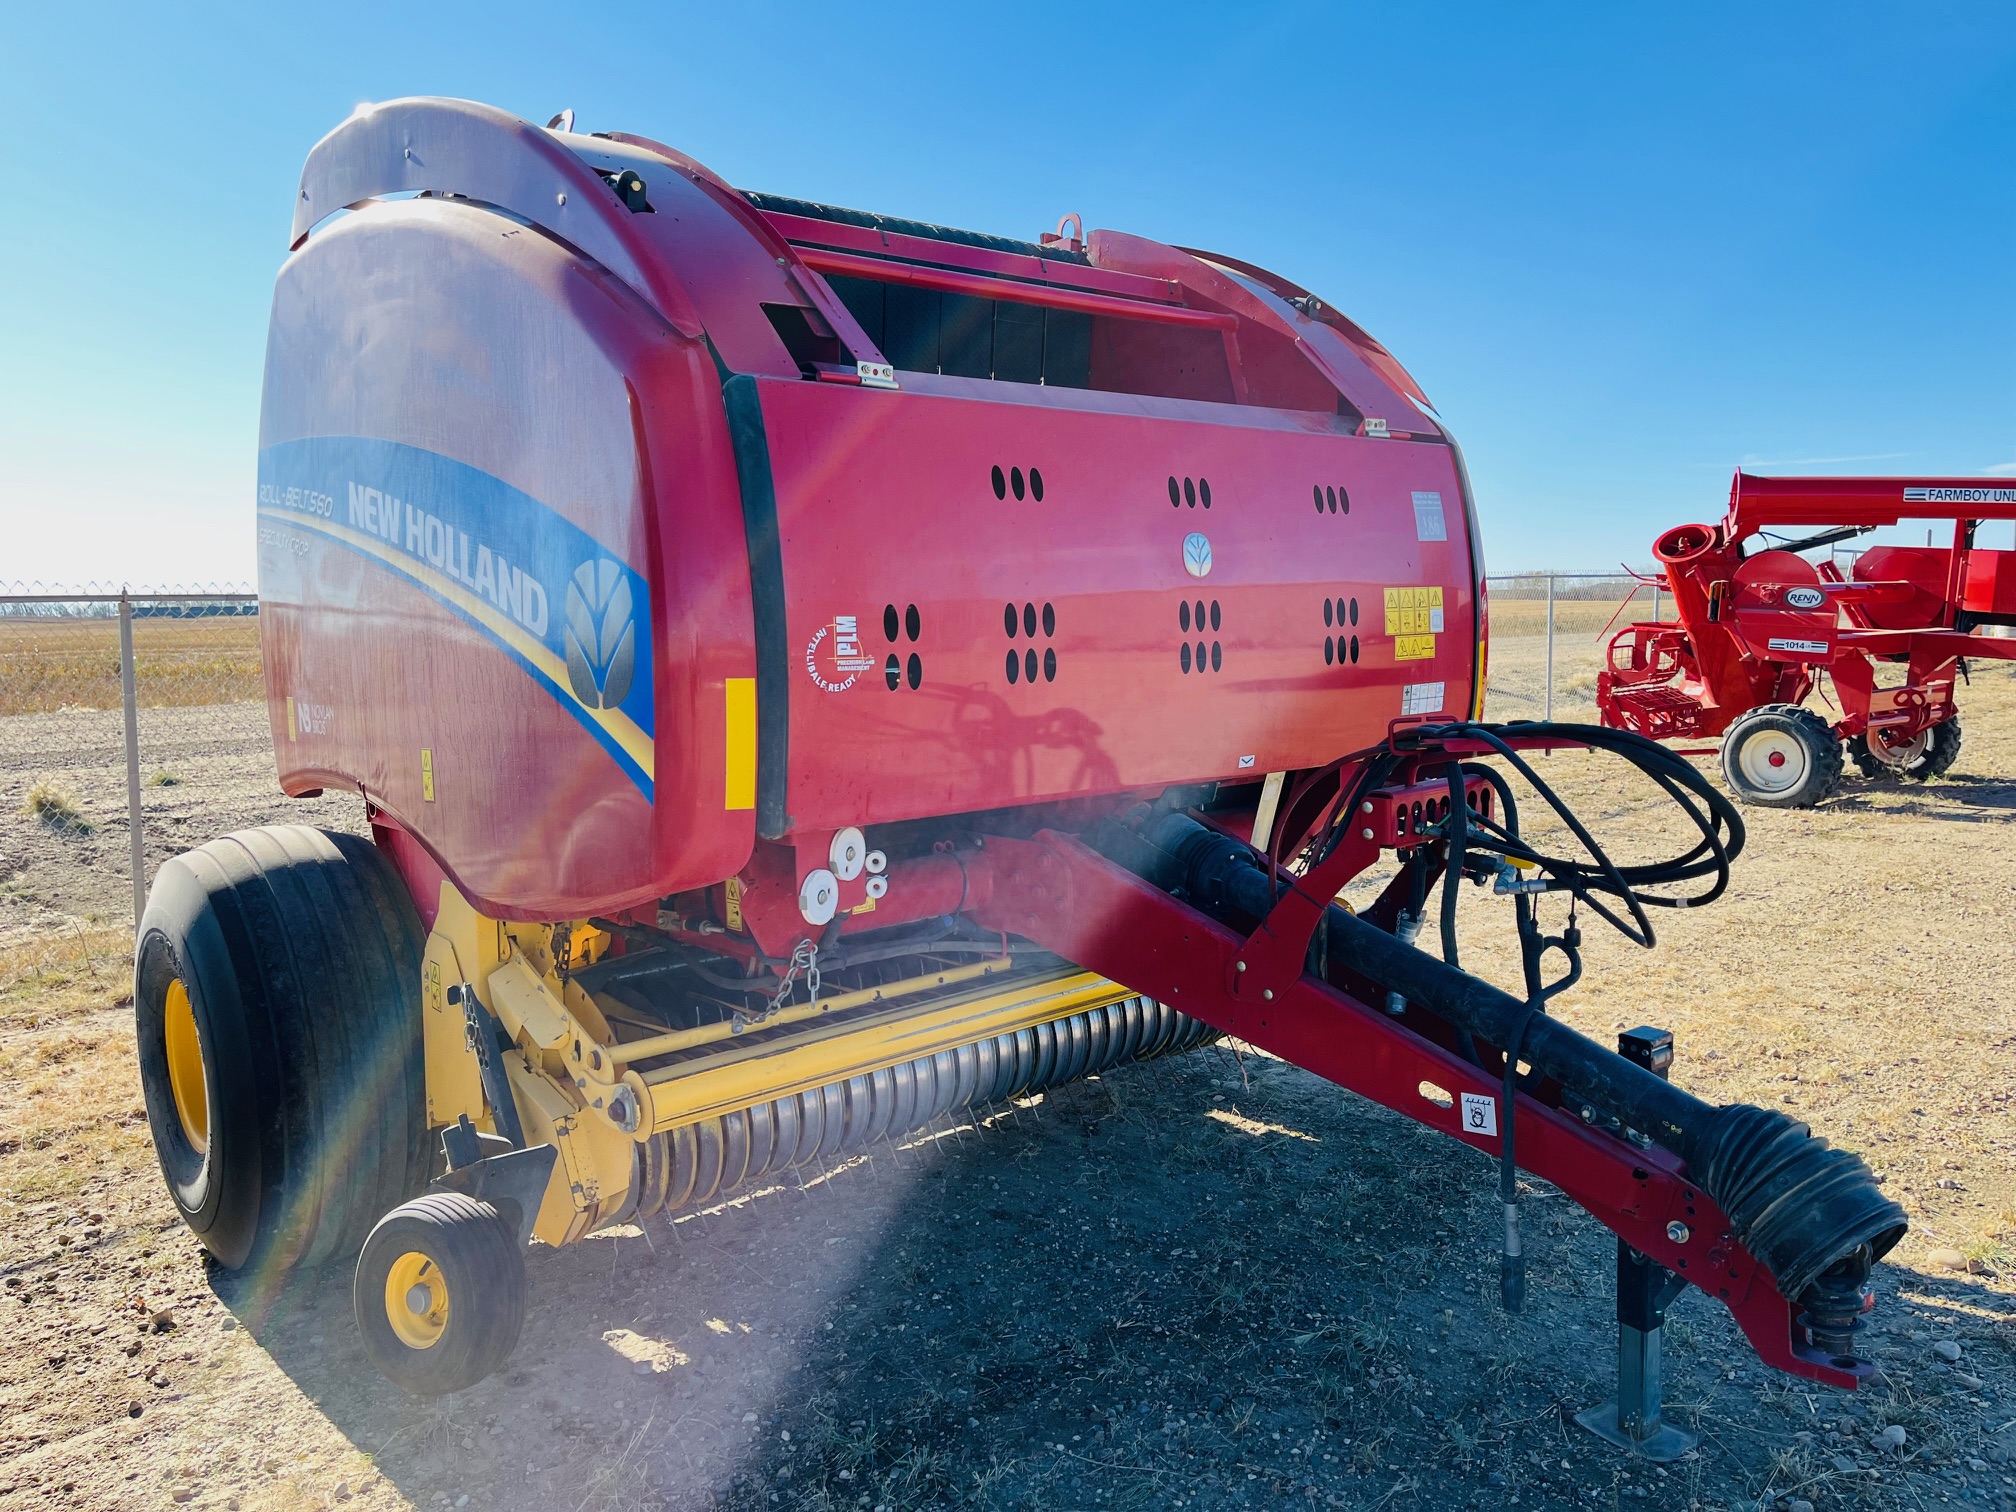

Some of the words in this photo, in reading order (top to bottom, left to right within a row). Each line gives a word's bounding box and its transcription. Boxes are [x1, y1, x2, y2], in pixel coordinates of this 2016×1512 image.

[309, 491, 333, 517] 560
[1928, 489, 1990, 502] FARMBOY
[290, 537, 309, 557] CROP
[348, 481, 401, 544] NEW
[406, 503, 549, 637] HOLLAND
[1790, 594, 1819, 604] RENN
[836, 616, 858, 656] PLM
[1785, 641, 1805, 649] 1014
[806, 627, 828, 688] INTELLIBALE
[828, 673, 857, 692] READY
